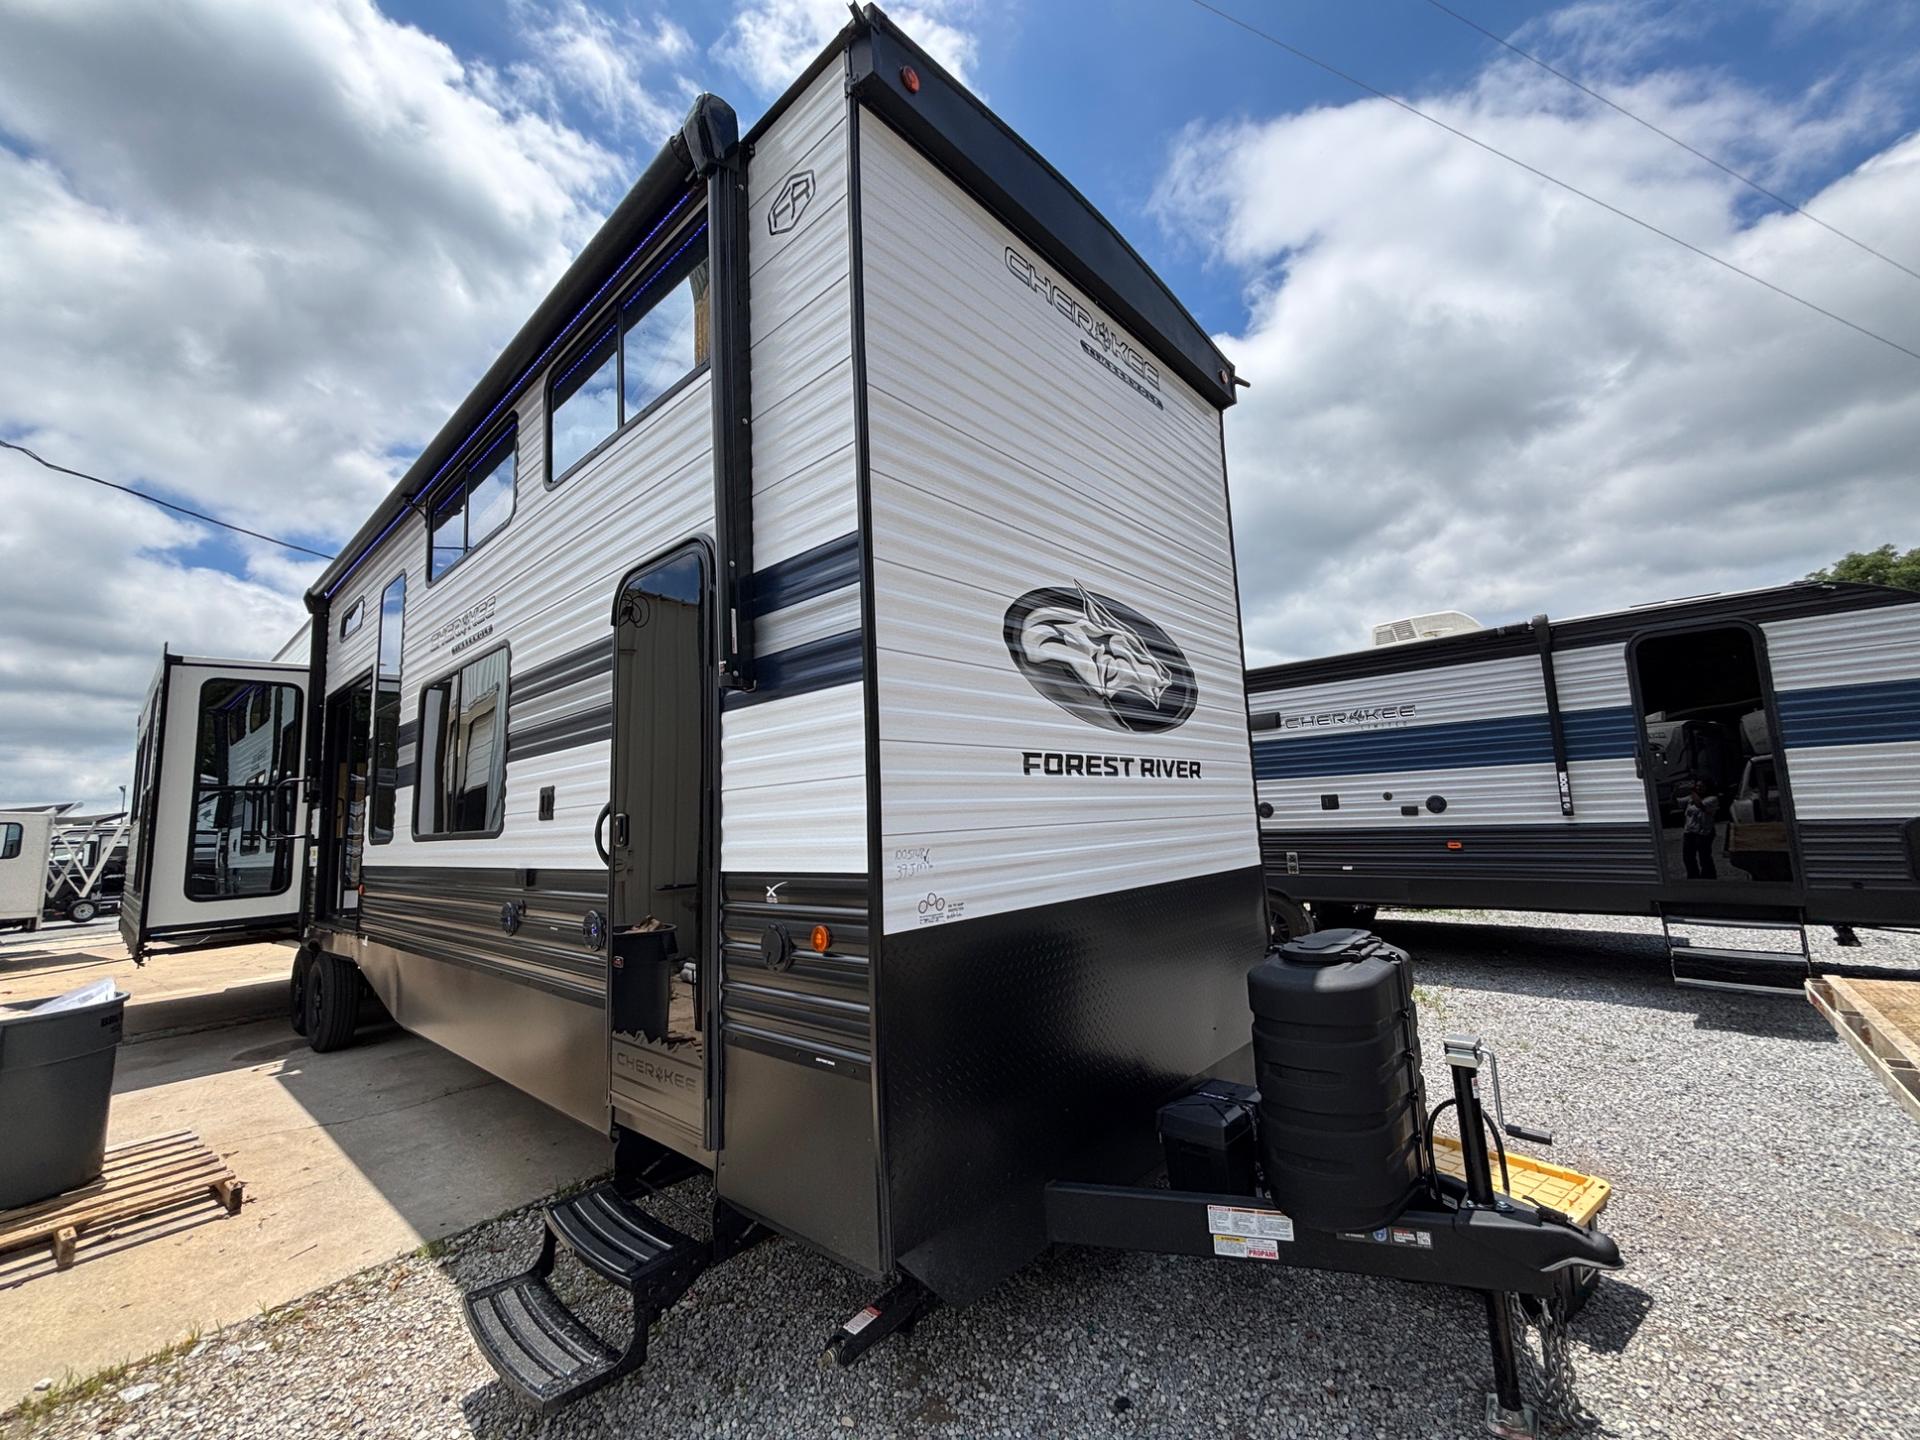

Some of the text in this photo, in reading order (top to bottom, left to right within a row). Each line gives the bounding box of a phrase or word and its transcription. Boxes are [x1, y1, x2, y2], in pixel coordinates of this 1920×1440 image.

[1004, 246, 1161, 391] CHEROKEE
[1285, 705, 1416, 730] CHEROKEE
[1021, 752, 1202, 779] FOREST RIVER
[616, 1052, 697, 1090] CHEROKEE
[1248, 1249, 1277, 1258] PROPANE
